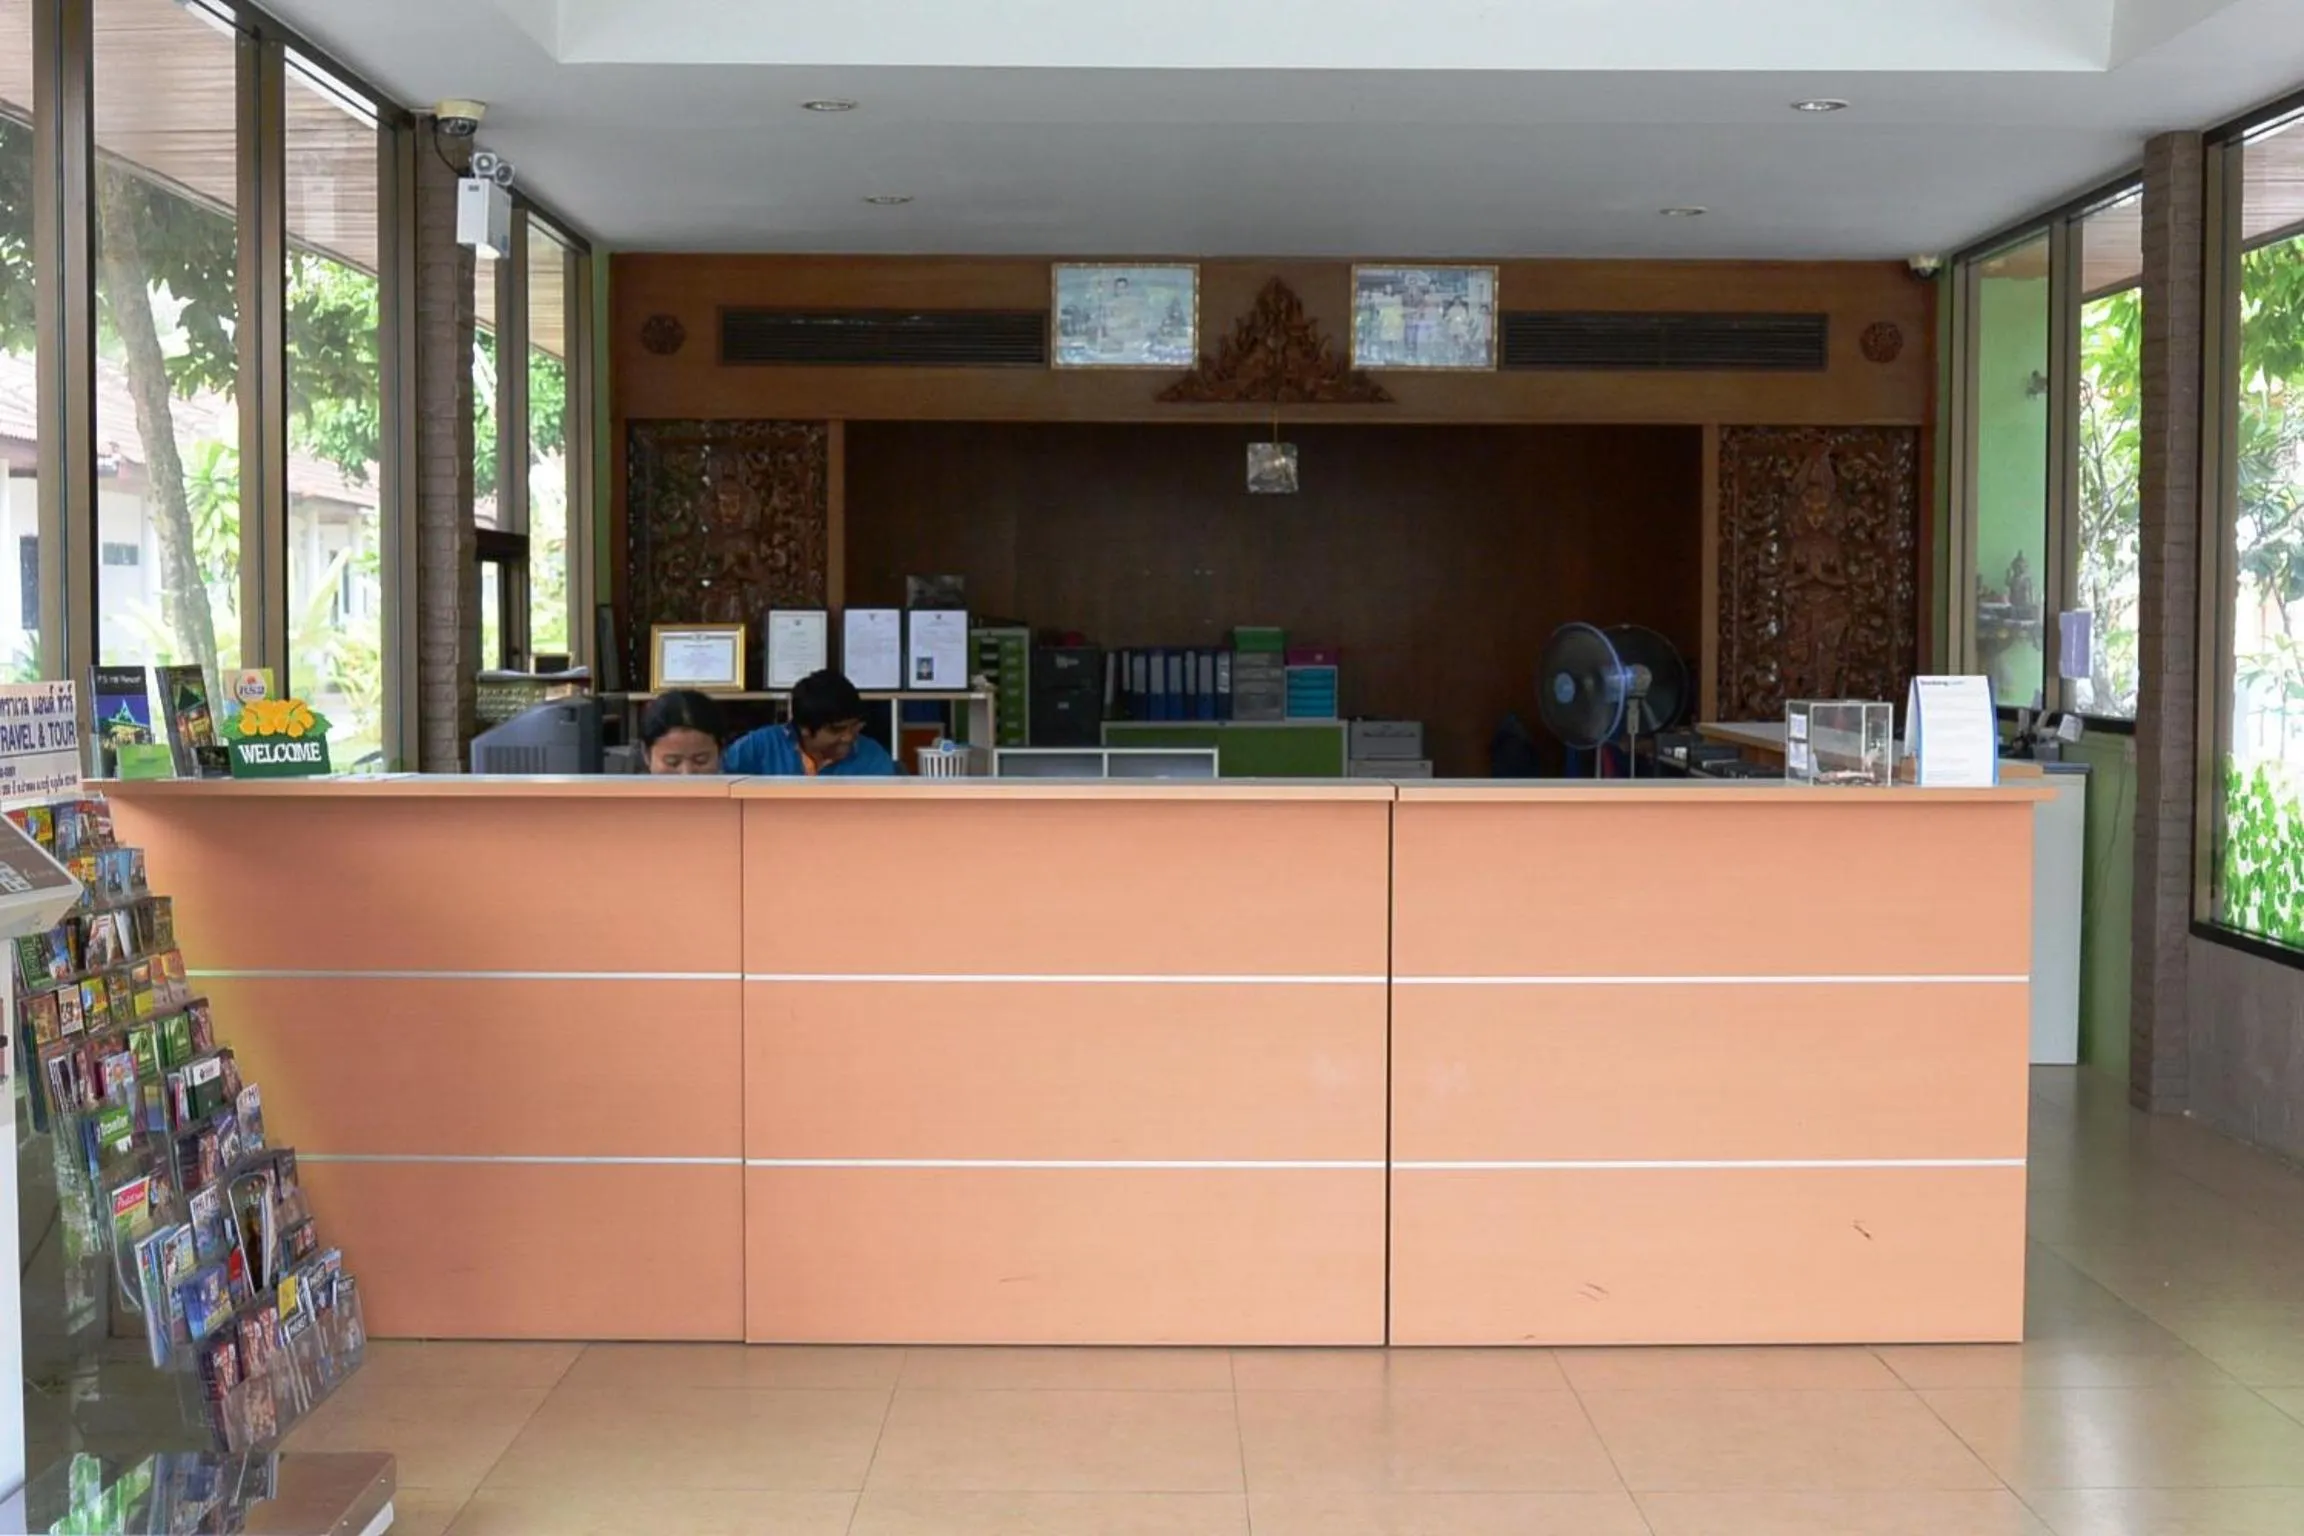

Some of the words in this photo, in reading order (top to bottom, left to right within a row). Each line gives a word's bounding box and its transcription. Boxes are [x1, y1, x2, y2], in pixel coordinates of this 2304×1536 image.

[0, 723, 36, 753] RAVEL
[38, 722, 46, 748] &
[47, 720, 77, 748] TOUR
[237, 742, 322, 764] WELCOME
